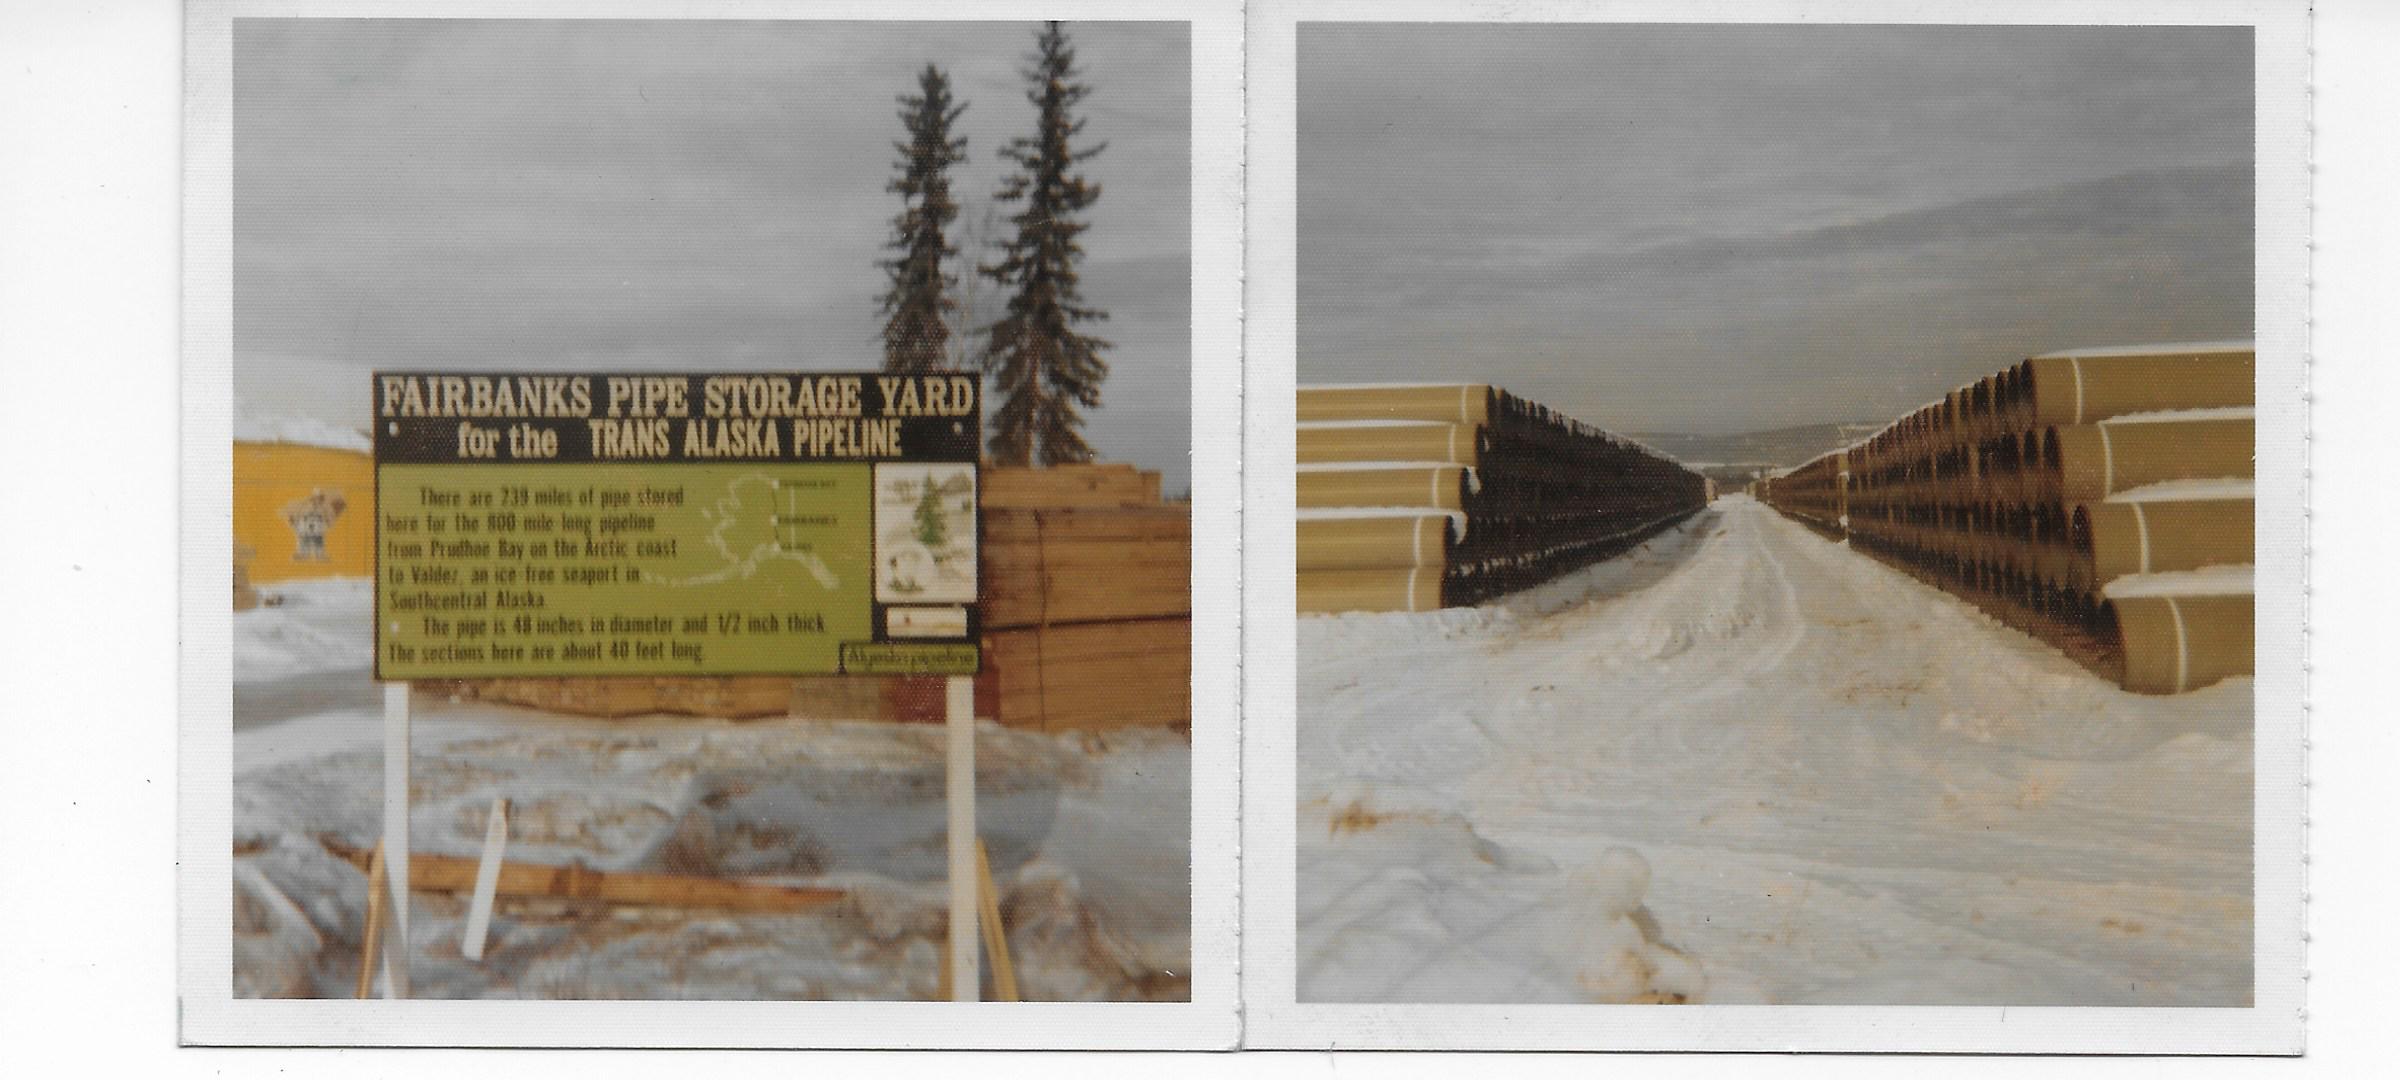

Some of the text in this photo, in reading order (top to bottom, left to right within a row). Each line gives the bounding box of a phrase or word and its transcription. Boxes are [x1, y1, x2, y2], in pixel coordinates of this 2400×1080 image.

[381, 376, 974, 418] FAIRBANKS PIPE STORAGE YARD
[457, 416, 901, 458] for the TRANS ALASKA PIPELINE
[419, 486, 462, 507] There
[468, 492, 493, 507] are
[534, 488, 573, 507] miles
[578, 487, 594, 507] of
[600, 491, 631, 511] pipe
[637, 486, 685, 507] stored
[385, 514, 419, 533] here
[426, 514, 446, 533] for
[454, 513, 480, 533] the
[523, 513, 554, 533] mile
[561, 513, 593, 538] long
[599, 513, 656, 536] pipeline
[387, 537, 677, 561] from Prudhoe Bay on the Arctic coast
[388, 565, 405, 586] to
[470, 569, 489, 586] an
[562, 565, 618, 587] seaport
[625, 566, 641, 583] in
[389, 591, 488, 612] Southcentral
[422, 616, 450, 638] The
[456, 620, 487, 640] pipe
[493, 620, 507, 636] is
[512, 614, 532, 636] 48
[536, 615, 585, 636] inches
[590, 617, 606, 635] in
[609, 615, 673, 636] diameter
[681, 615, 709, 635] and
[717, 613, 742, 636] 1/2
[747, 614, 780, 634] inch
[388, 642, 416, 665] The
[421, 644, 485, 664] sections
[491, 642, 525, 662] here
[531, 646, 555, 662] are
[561, 641, 602, 661] about
[609, 640, 630, 661] 40
[635, 641, 664, 661] feet
